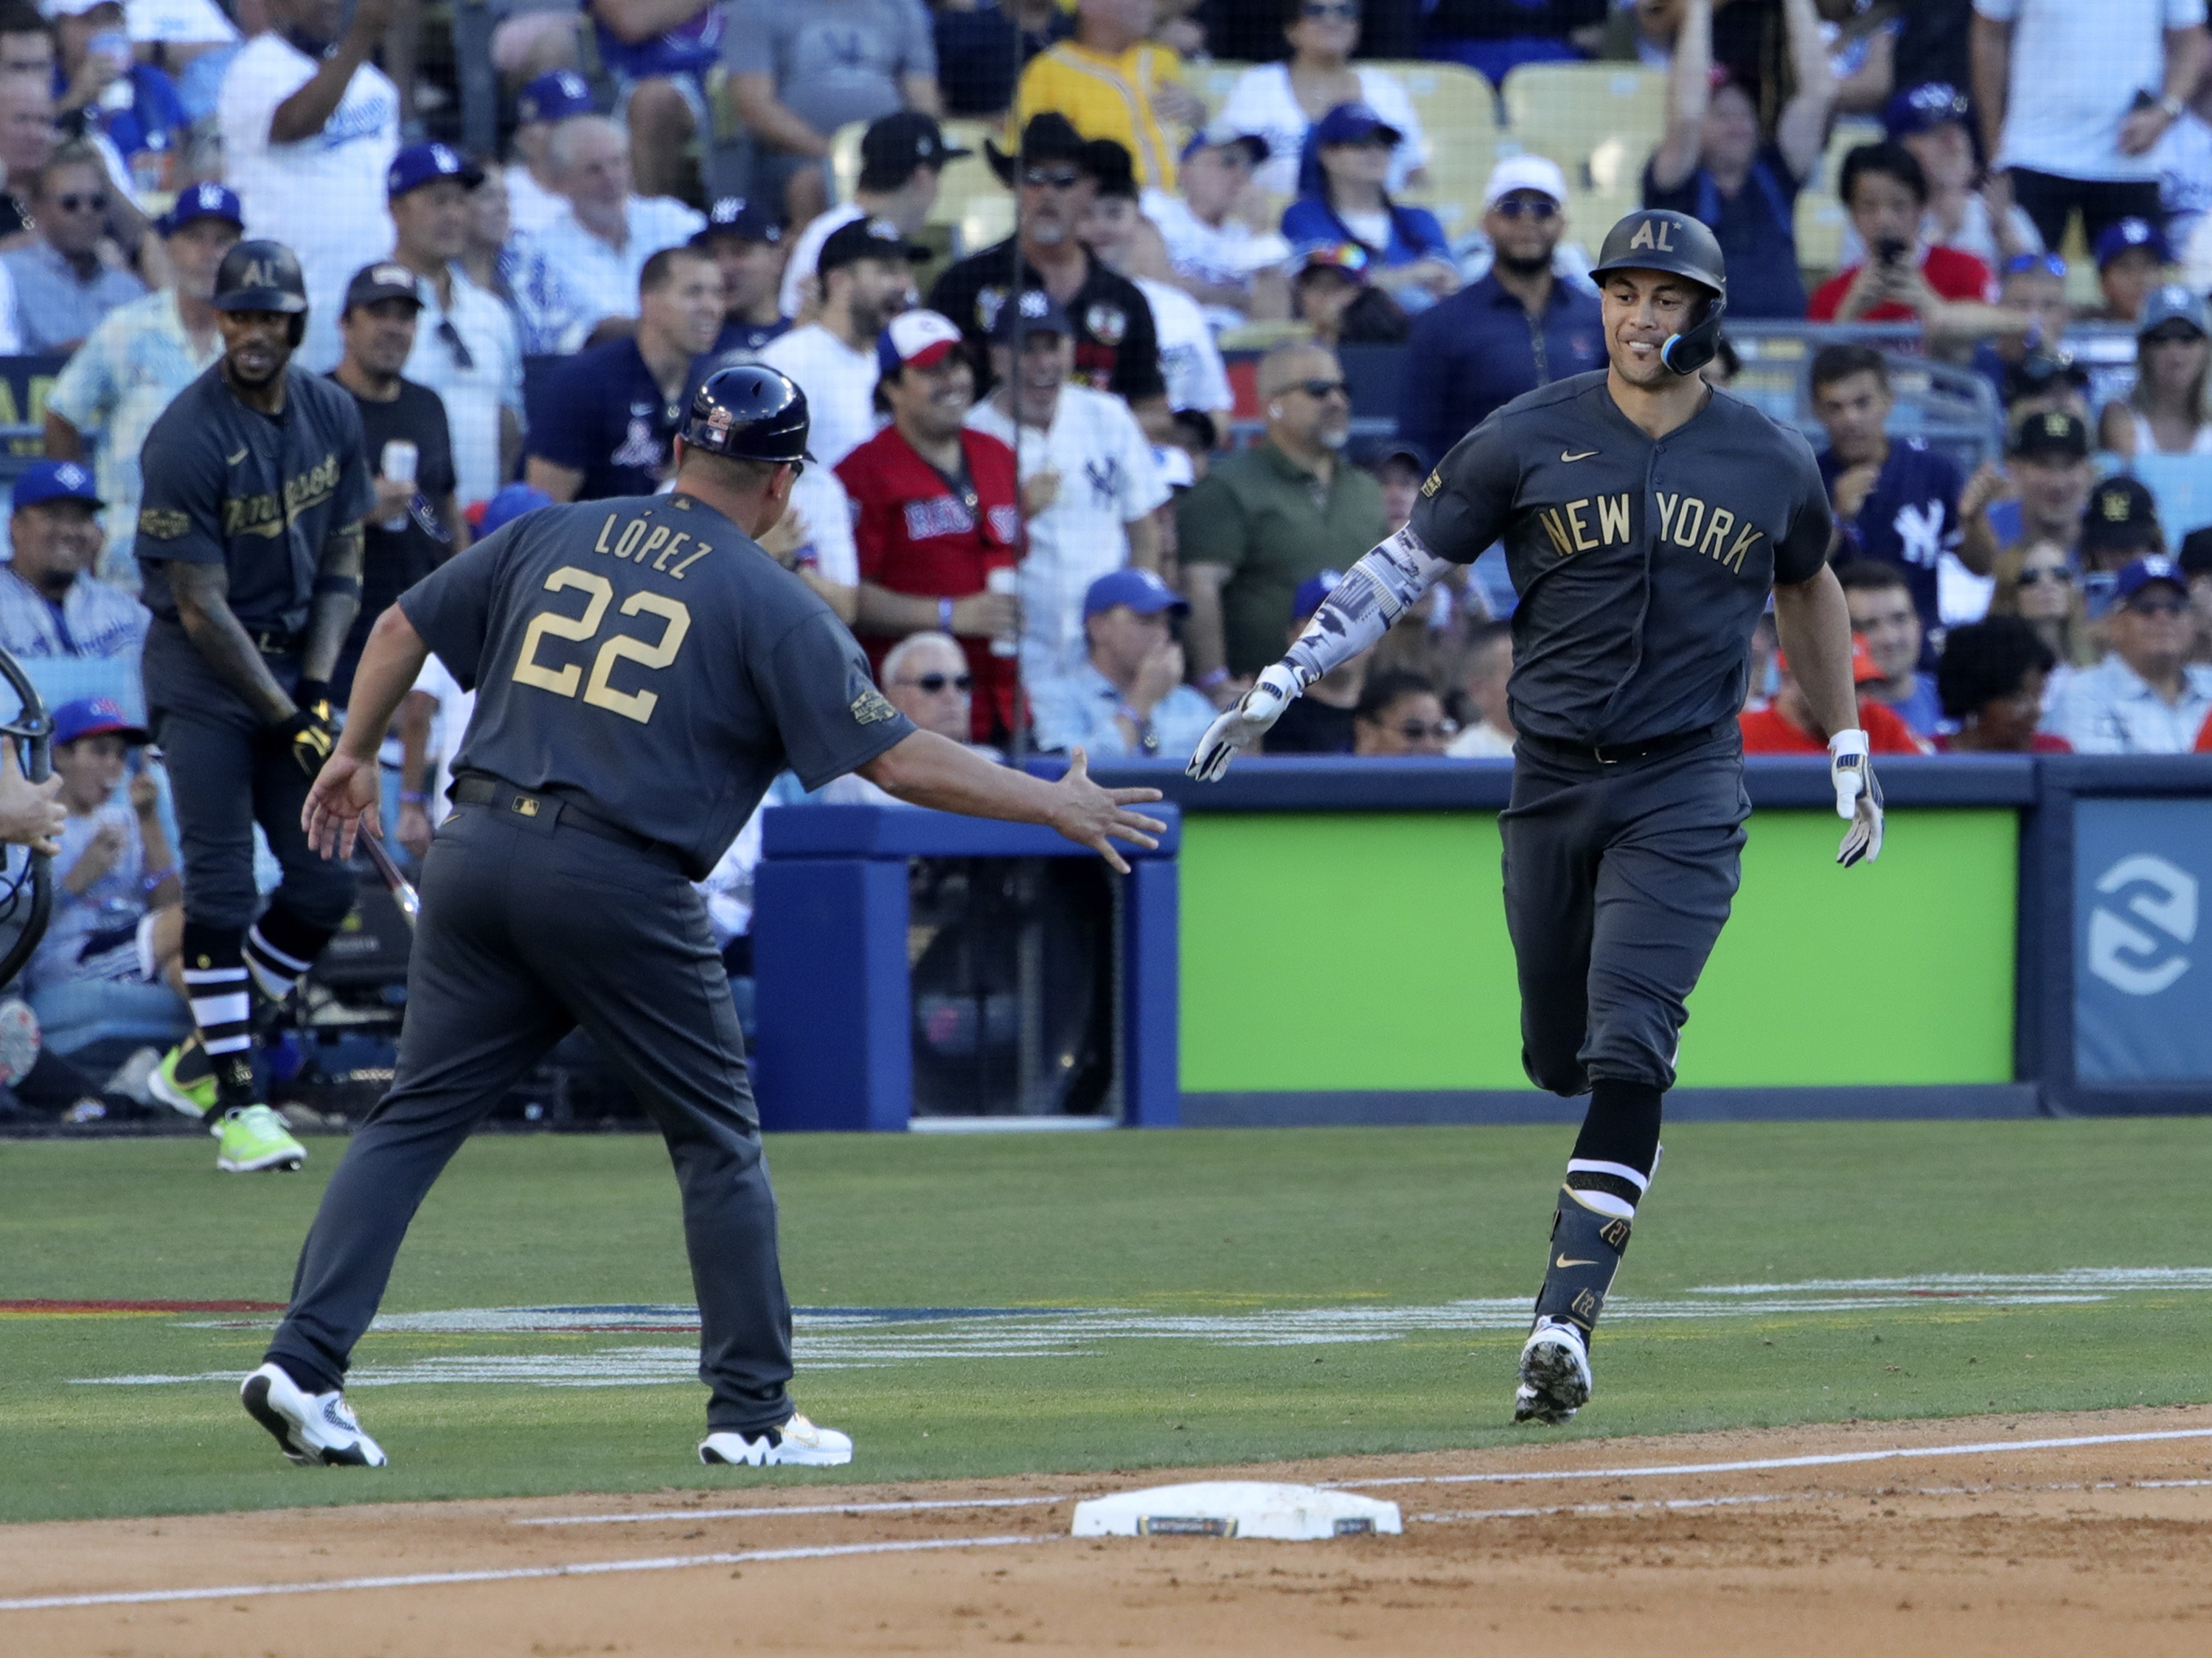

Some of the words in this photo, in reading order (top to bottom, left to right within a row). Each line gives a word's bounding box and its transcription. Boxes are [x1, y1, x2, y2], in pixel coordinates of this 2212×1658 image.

[1630, 220, 1674, 252] AL
[240, 260, 277, 288] AL
[708, 407, 732, 431] 22
[594, 510, 713, 580] LÓPEZ
[1540, 493, 1630, 558] NEW
[1655, 492, 1764, 575] YORK
[514, 566, 691, 724] 22
[1607, 1221, 1628, 1247] 27
